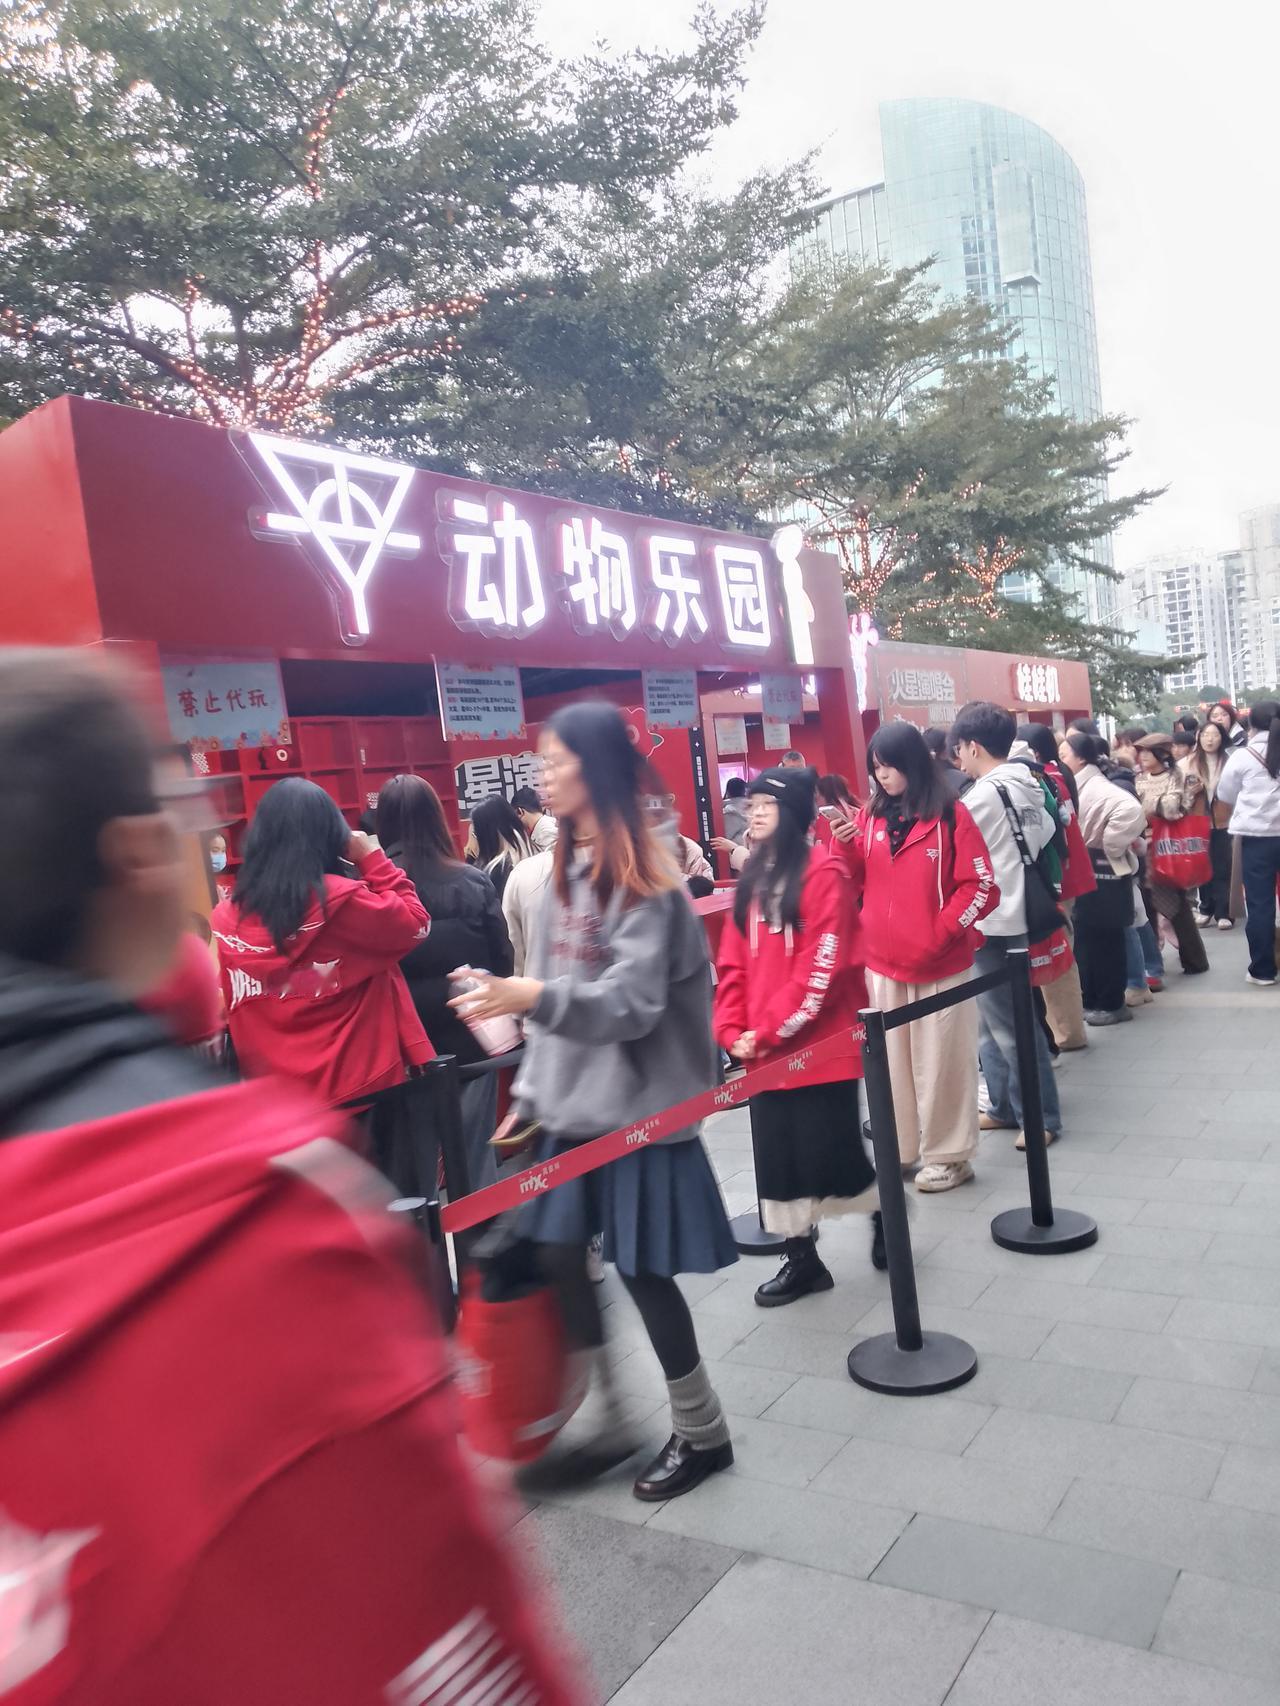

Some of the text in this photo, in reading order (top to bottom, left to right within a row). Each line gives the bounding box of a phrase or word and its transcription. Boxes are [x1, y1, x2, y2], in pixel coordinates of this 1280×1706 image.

[453, 501, 771, 648] 动物乐园
[177, 687, 268, 718] 禁止代玩
[455, 753, 546, 810] 星演
